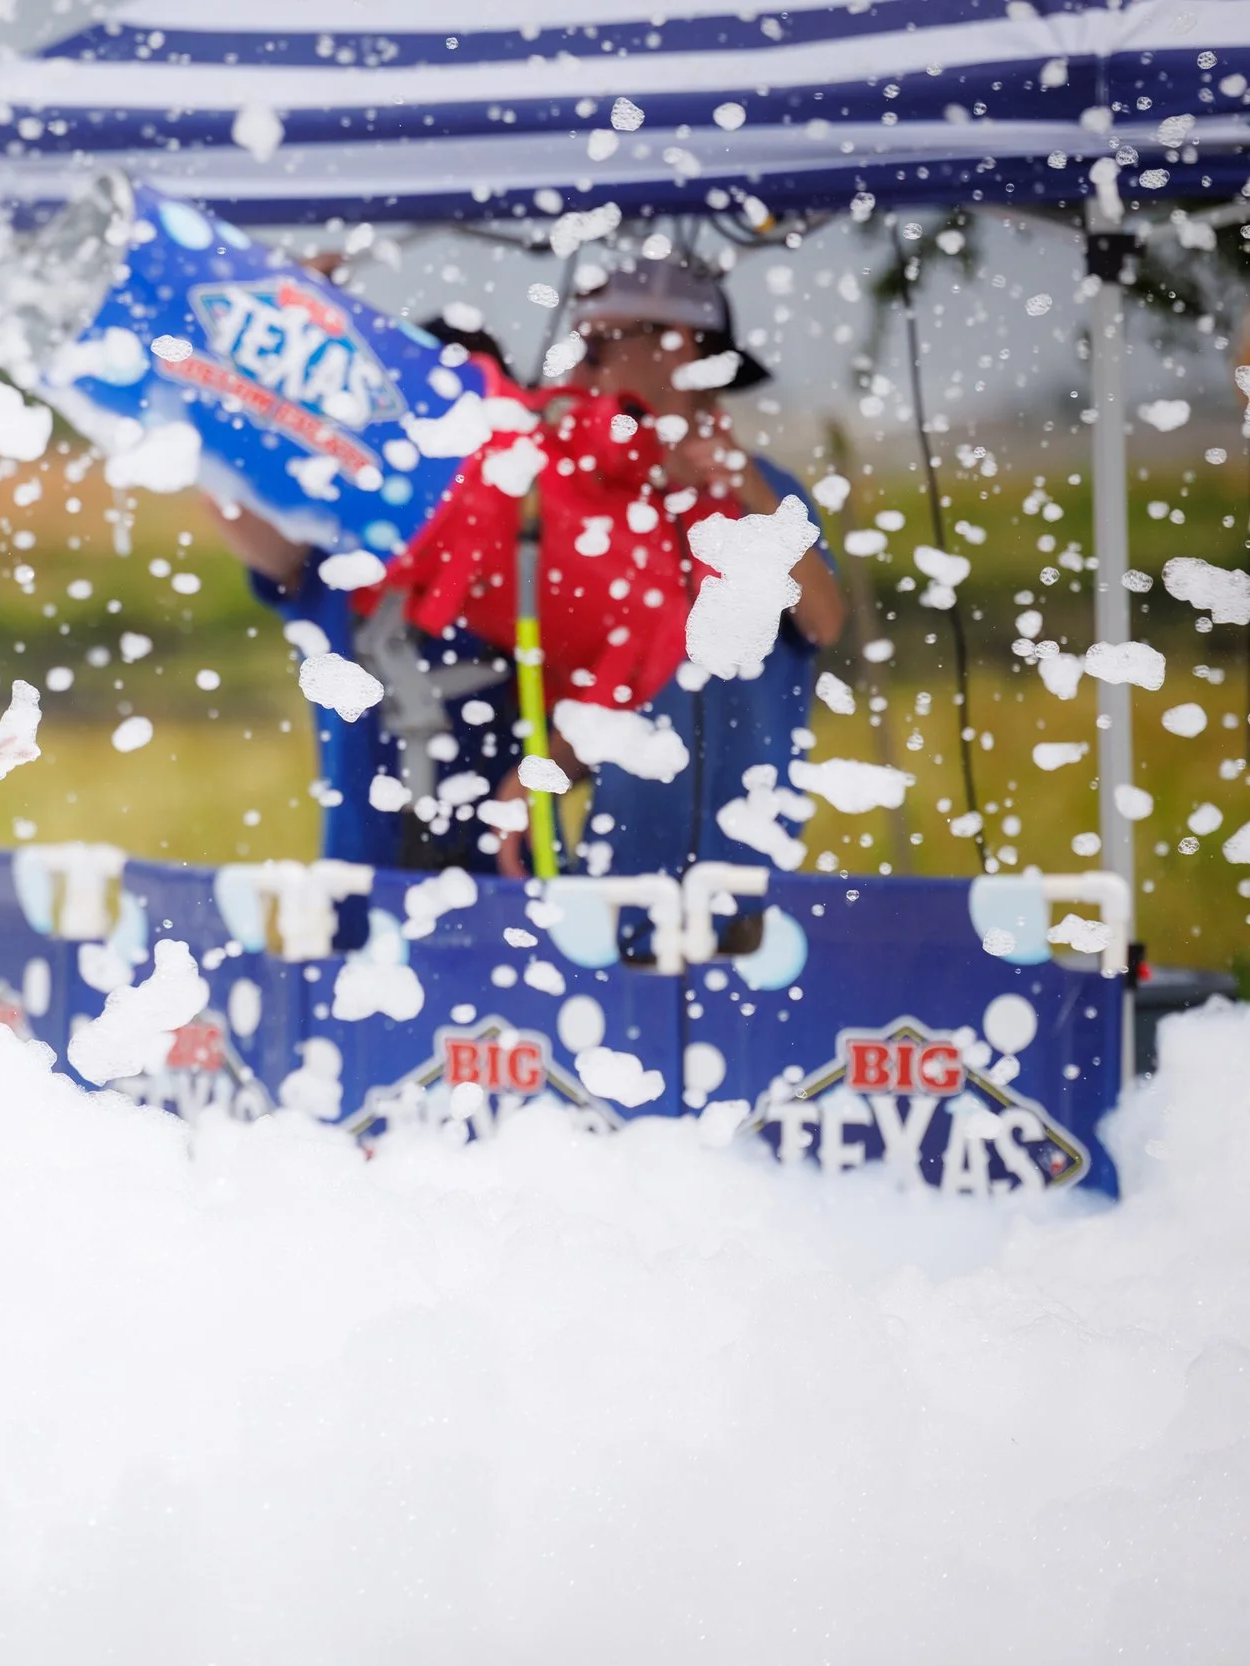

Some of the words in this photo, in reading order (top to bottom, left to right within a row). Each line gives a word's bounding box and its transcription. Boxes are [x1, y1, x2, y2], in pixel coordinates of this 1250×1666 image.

[207, 287, 384, 422] TEXAS
[445, 1037, 542, 1091] BIG
[849, 1040, 963, 1091] BIG
[768, 1097, 1050, 1198] TEXAS
